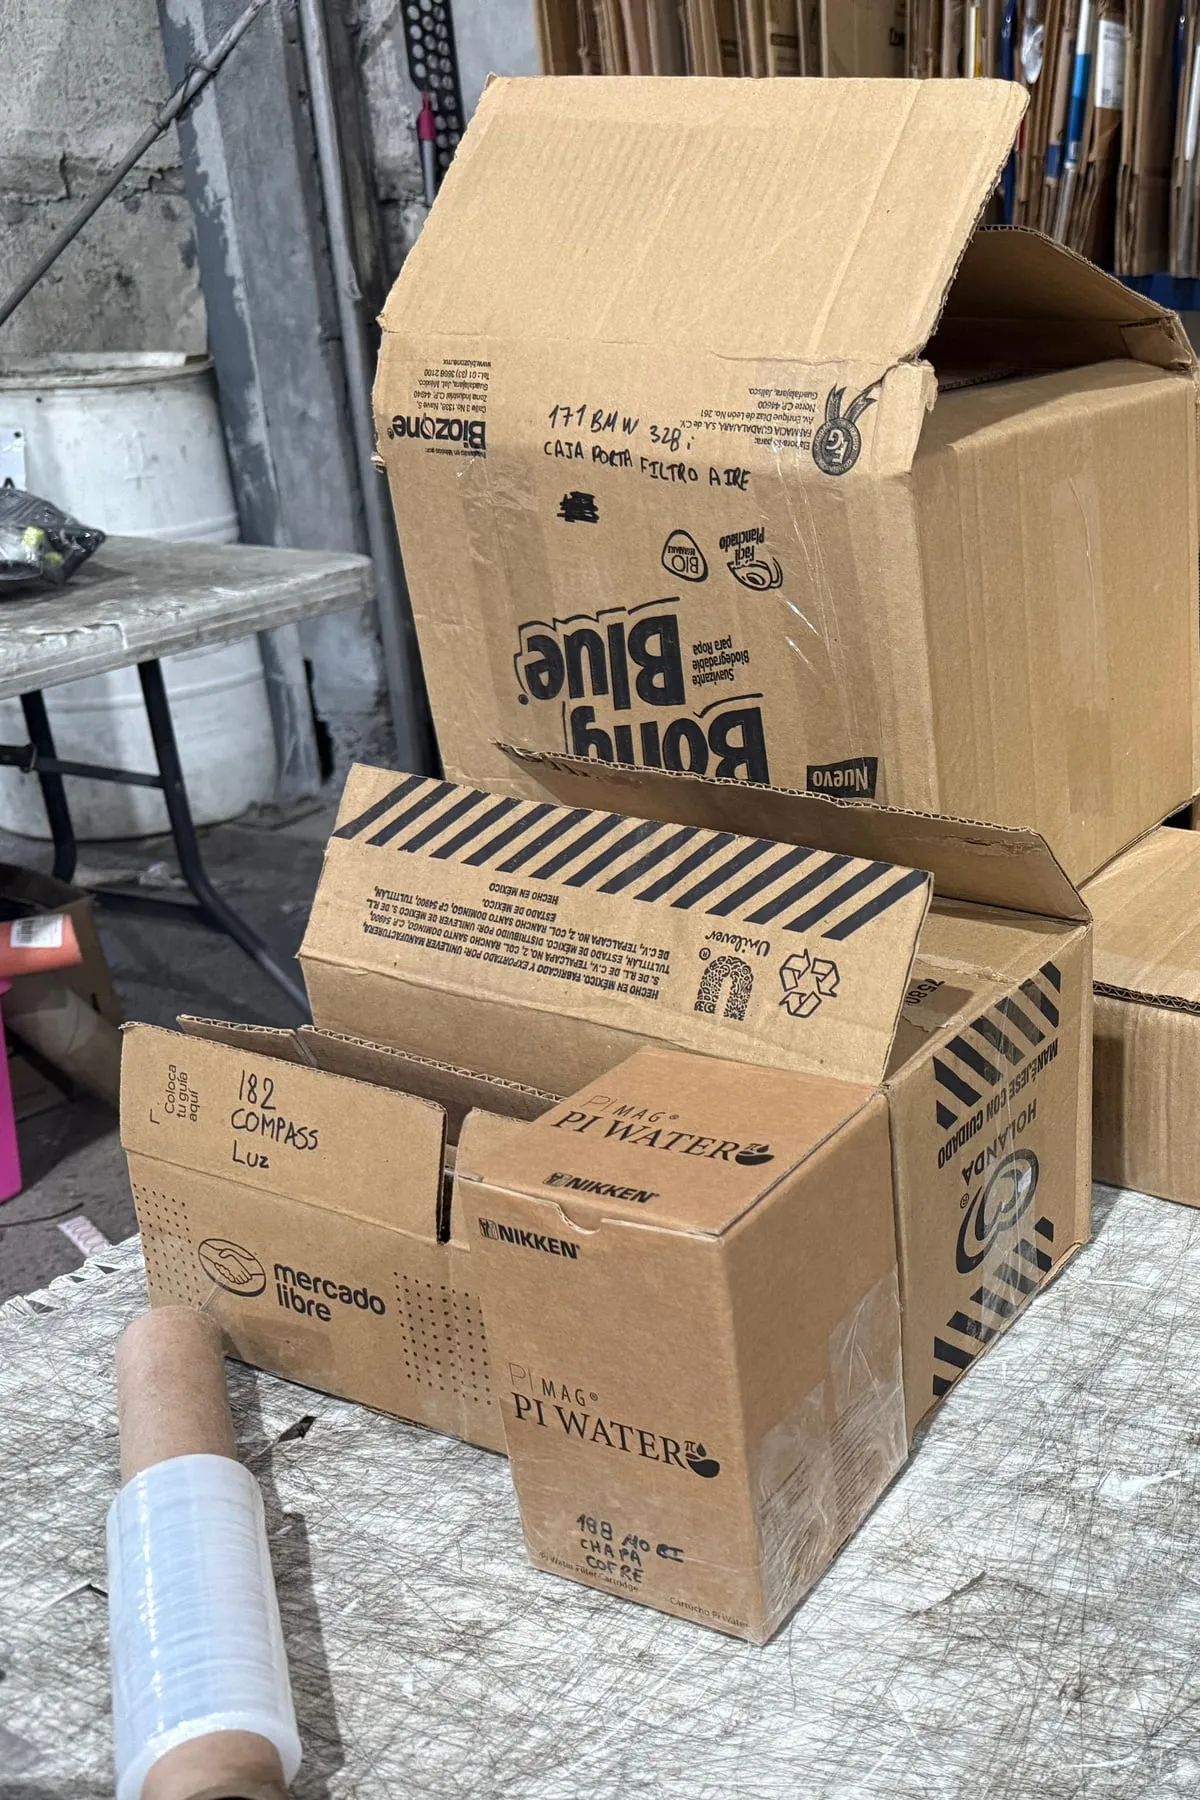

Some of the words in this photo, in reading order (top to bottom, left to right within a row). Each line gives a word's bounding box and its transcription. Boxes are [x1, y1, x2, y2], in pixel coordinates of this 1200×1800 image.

[423, 368, 439, 376] 2100
[446, 392, 471, 401] Industrial
[472, 393, 487, 402] Zona
[549, 404, 586, 429] 171
[591, 409, 639, 436] BMW
[745, 411, 755, 420] de
[391, 412, 487, 450] Biozone
[544, 440, 584, 459] CAJA
[592, 446, 633, 468] PORTA
[640, 457, 698, 484] FILTRO
[709, 467, 751, 491] AIRE
[719, 527, 765, 552] Planchado
[671, 555, 699, 574] BIO
[735, 546, 755, 566] Fácil
[692, 638, 711, 656] Ropa
[712, 635, 733, 653] para
[526, 614, 686, 711] Blue
[692, 649, 750, 671] Biodegradable
[692, 667, 735, 686] Suavizante
[812, 769, 869, 791] Nuevo
[372, 886, 414, 906] TULTITLÁN,
[487, 881, 518, 898] MÉXICO
[519, 888, 530, 898] EN
[531, 890, 558, 905] HECHO
[365, 898, 380, 909] R.L.
[379, 902, 390, 911] DE
[414, 895, 438, 909] 54900,
[449, 902, 487, 920] DOMINGO,
[480, 898, 512, 914] MÉXICO.
[513, 905, 524, 915] DE
[368, 910, 392, 925] 54900,
[398, 906, 426, 921] MÉXICO
[427, 912, 438, 922] DE
[487, 912, 513, 926] SANTO
[525, 906, 556, 922] ESTADO
[405, 919, 442, 936] DOMINGO,
[438, 915, 476, 931] UNILEVER
[475, 923, 494, 935] POR:
[514, 918, 547, 933] RANCHO
[547, 925, 566, 937] COL.
[361, 921, 425, 946] MANUFACTURERA,
[442, 929, 468, 942] SANTO
[469, 935, 501, 950] RANCHO
[495, 927, 544, 946] DISTRIBUIDO
[575, 931, 590, 942] NO.
[425, 938, 463, 955] UNILEVER
[463, 946, 482, 959] POR:
[501, 942, 519, 954] COL.
[544, 938, 577, 955] MÉXICO.
[577, 946, 588, 956] DE
[589, 934, 637, 953] TEPALCAPA
[637, 943, 657, 957] C.V.,
[705, 931, 771, 957] Unilever
[482, 951, 529, 970] EXPORTADO
[529, 948, 543, 959] NO.
[544, 951, 588, 970] TEPALCAPA
[589, 948, 623, 964] ESTADO
[656, 949, 670, 960] DE
[535, 963, 582, 982] FABRICADO
[588, 961, 607, 974] C.V.,
[608, 966, 620, 977] DE
[620, 969, 636, 980] R.L.
[623, 955, 671, 976] TULTITLÁN,
[580, 973, 616, 992] MÉXICO.
[616, 982, 628, 992] EN
[637, 973, 649, 983] DE
[628, 984, 659, 1000] HECHO
[1008, 1038, 1058, 1101] MANÉJESE
[165, 1064, 177, 1114] Coloca
[177, 1071, 189, 1104] guía
[239, 1070, 276, 1110] 182
[176, 1105, 187, 1118] tu
[188, 1087, 201, 1122] aquí
[580, 1095, 618, 1112] PI
[986, 1087, 1008, 1123] CON
[231, 1108, 319, 1150] COMPASS
[551, 1110, 604, 1133] PI
[603, 1119, 740, 1161] WATER
[938, 1109, 984, 1169] CUIDADO
[961, 1098, 1037, 1186] HOLANDA
[564, 1177, 656, 1203] NIKKEN
[498, 1224, 579, 1260] NIKKEN
[274, 1263, 386, 1316] mercado
[276, 1282, 332, 1322] libre
[508, 1362, 534, 1392] PI
[511, 1391, 548, 1428] PI
[552, 1404, 687, 1470] WATER
[576, 1513, 613, 1542] 188
[581, 1538, 643, 1567] CHAPA
[586, 1554, 645, 1584] COFRE
[670, 1596, 710, 1617] Cartucho
